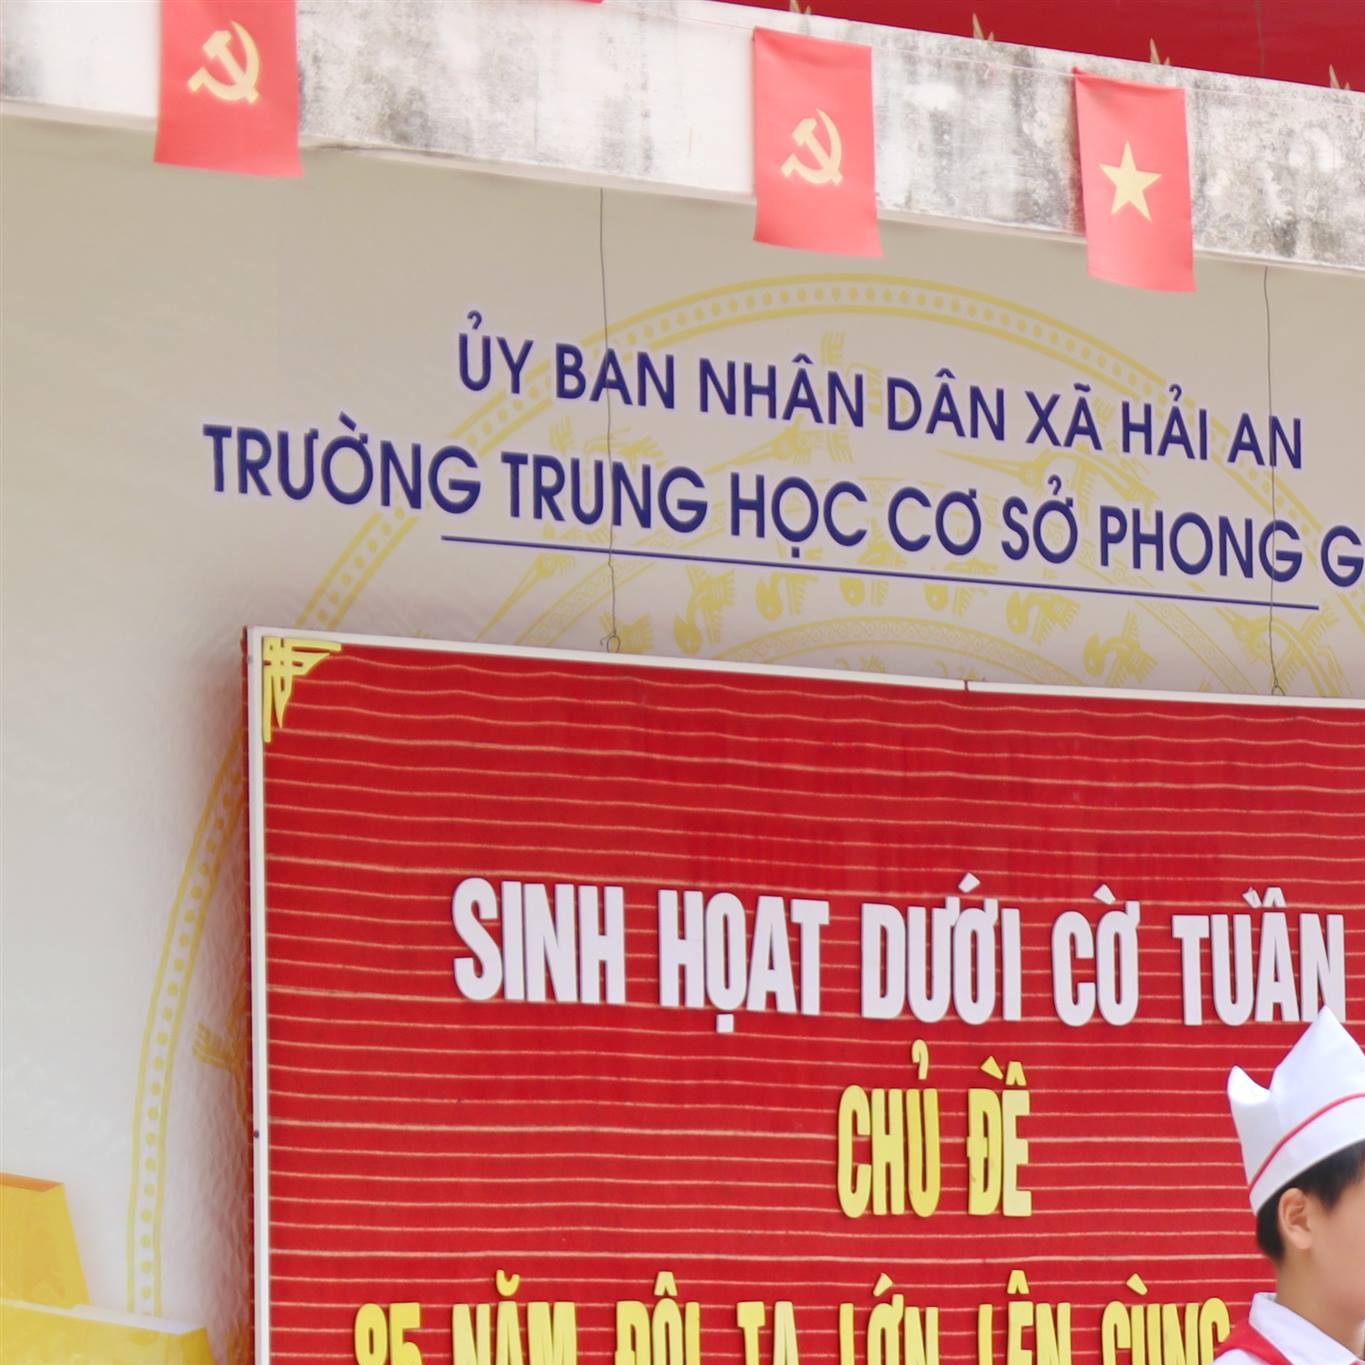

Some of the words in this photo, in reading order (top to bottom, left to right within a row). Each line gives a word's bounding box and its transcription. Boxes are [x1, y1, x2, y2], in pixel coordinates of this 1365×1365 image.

[458, 310, 534, 395] ỦY
[555, 342, 675, 411] BAN
[699, 353, 865, 429] NHÂN
[886, 367, 1005, 442] DÂN
[1025, 383, 1101, 452] XÃ
[1121, 384, 1208, 461] HẢI
[1227, 412, 1302, 470] AN
[202, 411, 483, 515] TRƯỜNG
[500, 451, 709, 535] TRUNG
[729, 471, 869, 558] HỌC
[887, 486, 982, 557] CƠ
[1000, 474, 1079, 565] SỞ
[1099, 505, 1303, 583] PHONG
[451, 877, 626, 1005] SINH
[657, 888, 831, 1035] HỌAT
[860, 871, 1022, 1026] DƯỚI
[1051, 882, 1141, 1028] CỜ
[1171, 886, 1347, 1027] TUẦN
[837, 1038, 942, 1219] CHỦ
[966, 1055, 1033, 1218] ĐỀ
